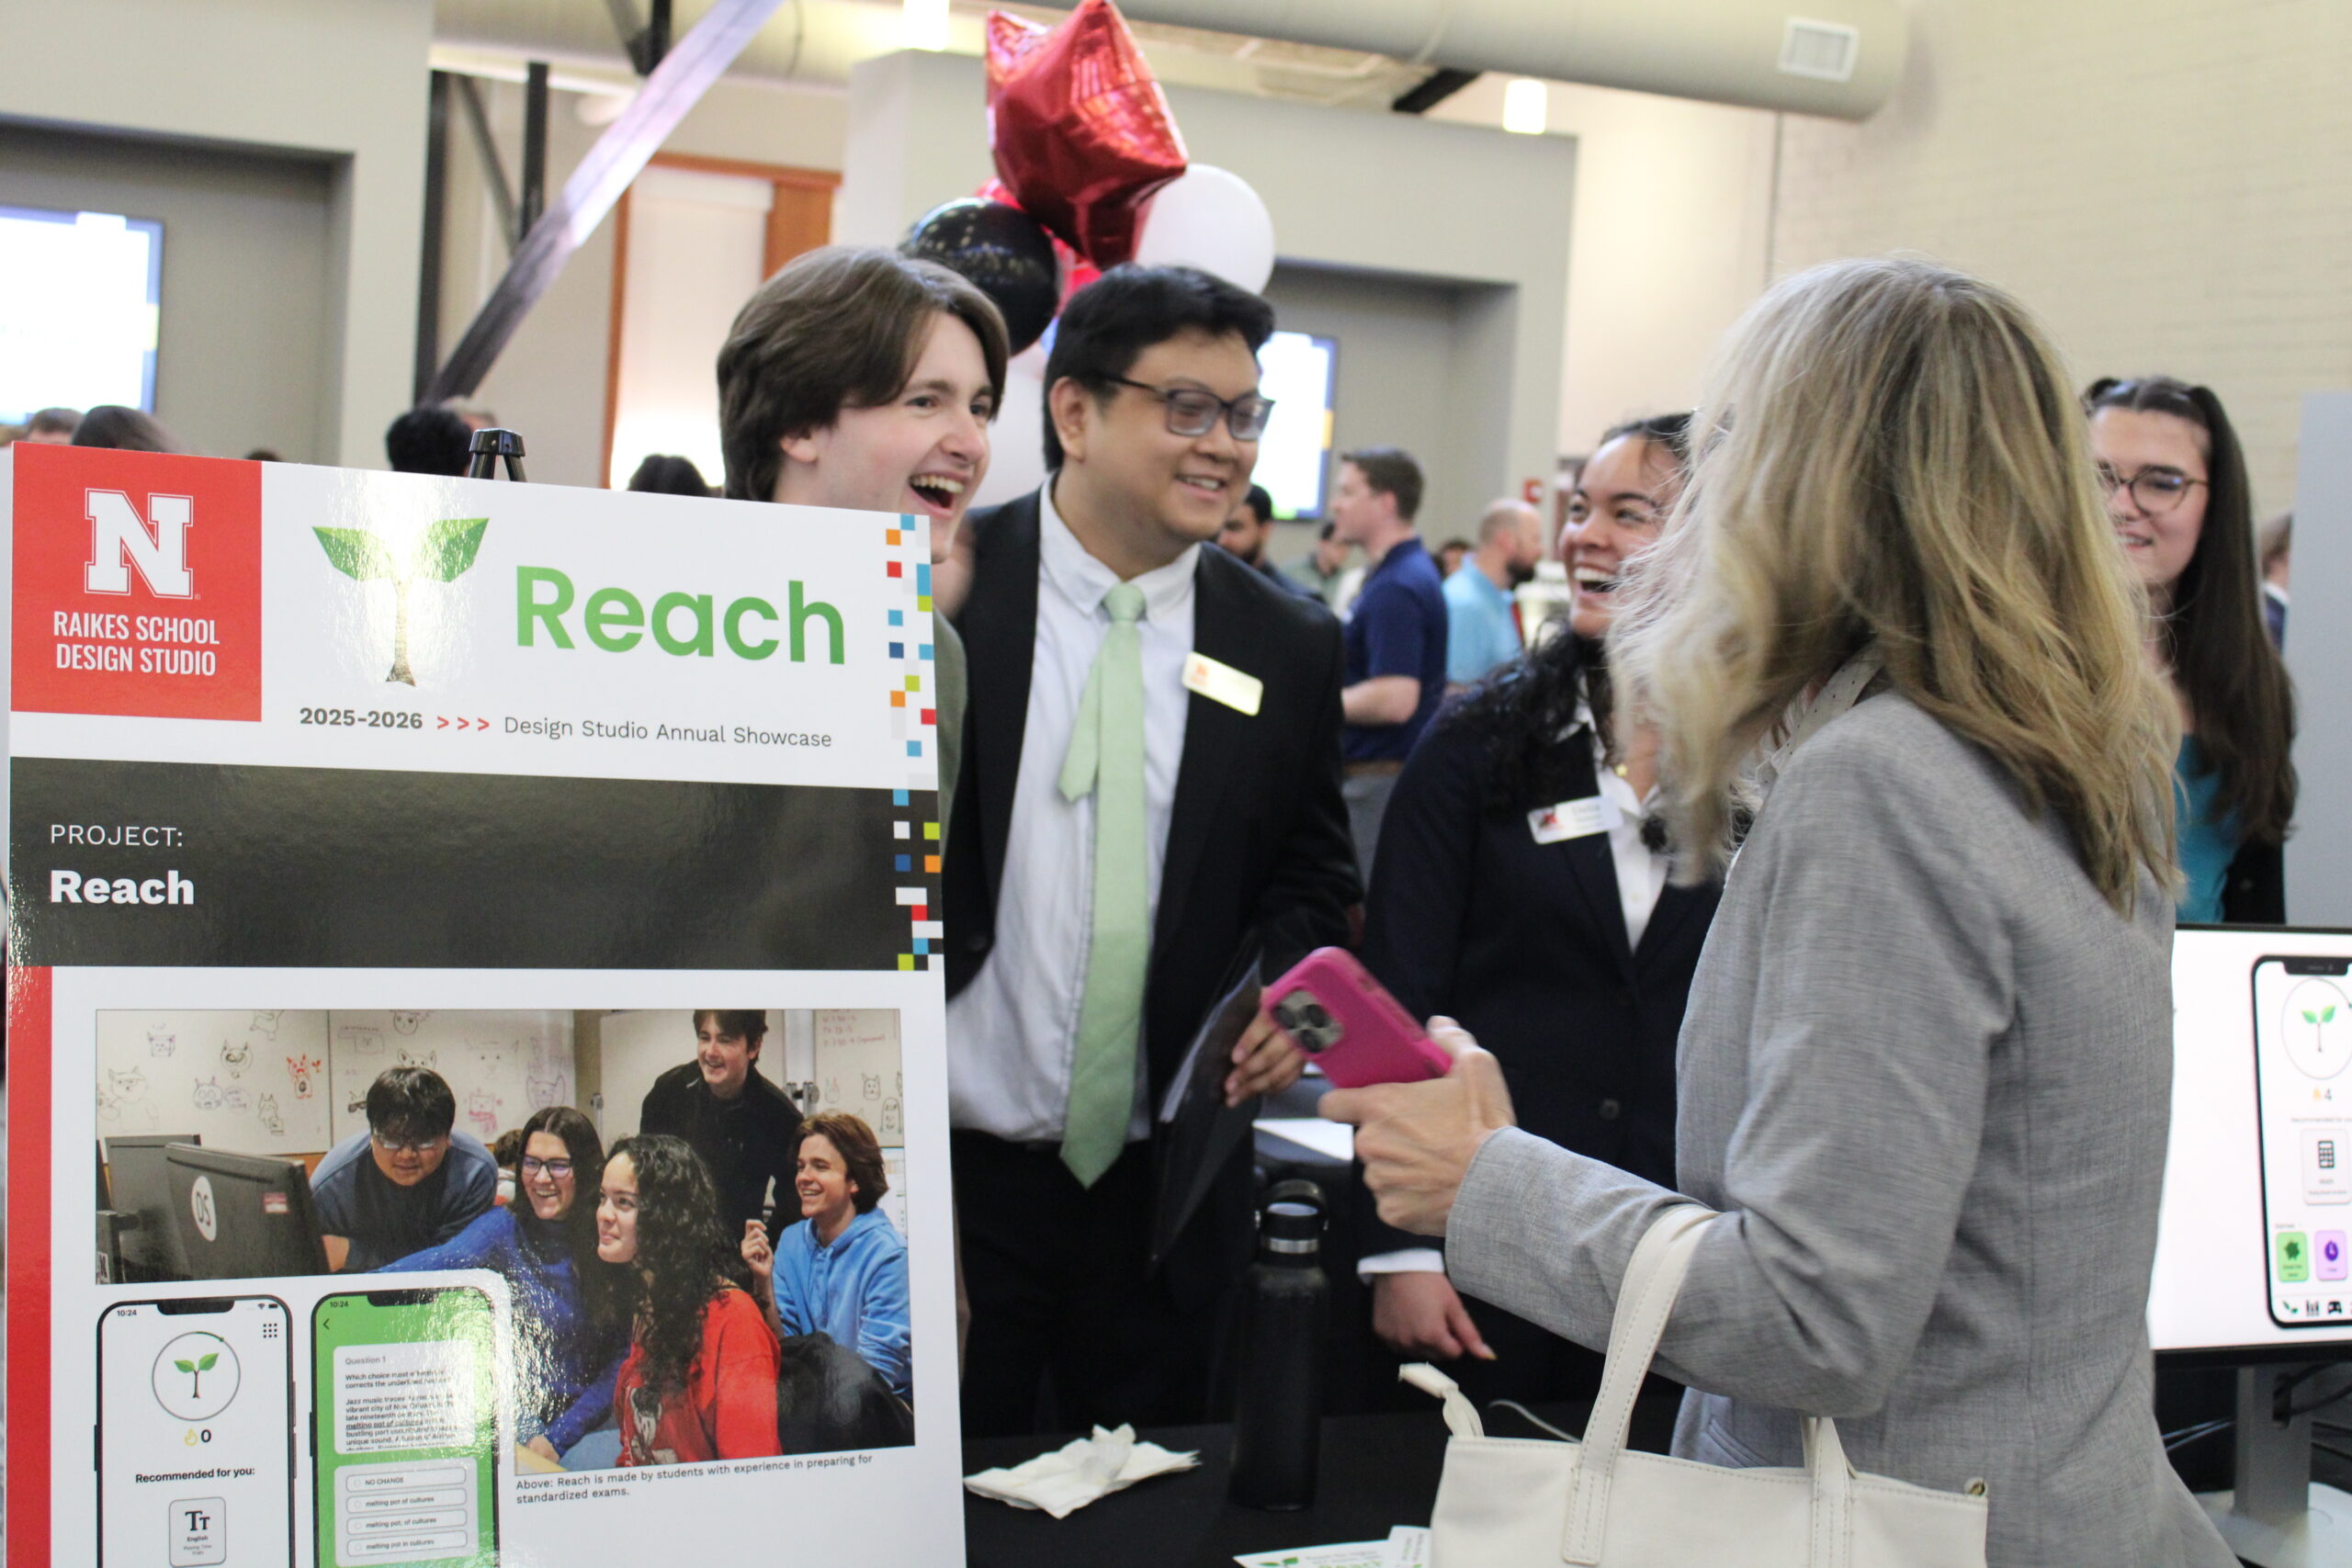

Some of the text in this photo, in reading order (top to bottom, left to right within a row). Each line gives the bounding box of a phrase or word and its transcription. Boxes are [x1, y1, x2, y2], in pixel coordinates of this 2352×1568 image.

[85, 488, 193, 600] N
[516, 565, 845, 665] Reach
[53, 610, 220, 646] RAIKES SCHOOL
[56, 643, 217, 676] DESIGN STUDIO
[299, 706, 832, 748] 2025-2026 Design Studio Annual Showcase
[50, 823, 184, 848] PROJECT:
[50, 868, 195, 906] Reach
[330, 1300, 349, 1308] 10:24
[117, 1309, 138, 1318] 10:24
[345, 1357, 381, 1366] Question
[345, 1373, 367, 1382] Which
[368, 1371, 390, 1380] choice
[345, 1381, 374, 1390] corrects
[375, 1380, 387, 1388] the
[345, 1397, 362, 1405] Jazz
[362, 1396, 383, 1404] music
[345, 1404, 370, 1414] vibrant
[370, 1404, 384, 1413] city
[345, 1414, 359, 1422] late
[200, 1428, 212, 1444] 0
[345, 1429, 374, 1438] bustling
[345, 1438, 370, 1446] unique
[135, 1467, 256, 1484] Recommended for you:
[515, 1453, 874, 1491] Above: Reach is made by students with experience in preparing for
[376, 1477, 404, 1485] CHANGE
[515, 1486, 630, 1505] standardized exams.
[365, 1498, 389, 1507] melting
[390, 1498, 401, 1506] pot
[410, 1496, 435, 1505] cultures
[366, 1520, 390, 1529] melting
[187, 1535, 209, 1543] English
[366, 1541, 390, 1551] melting
[390, 1540, 401, 1550] pot
[409, 1539, 435, 1548] cultures
